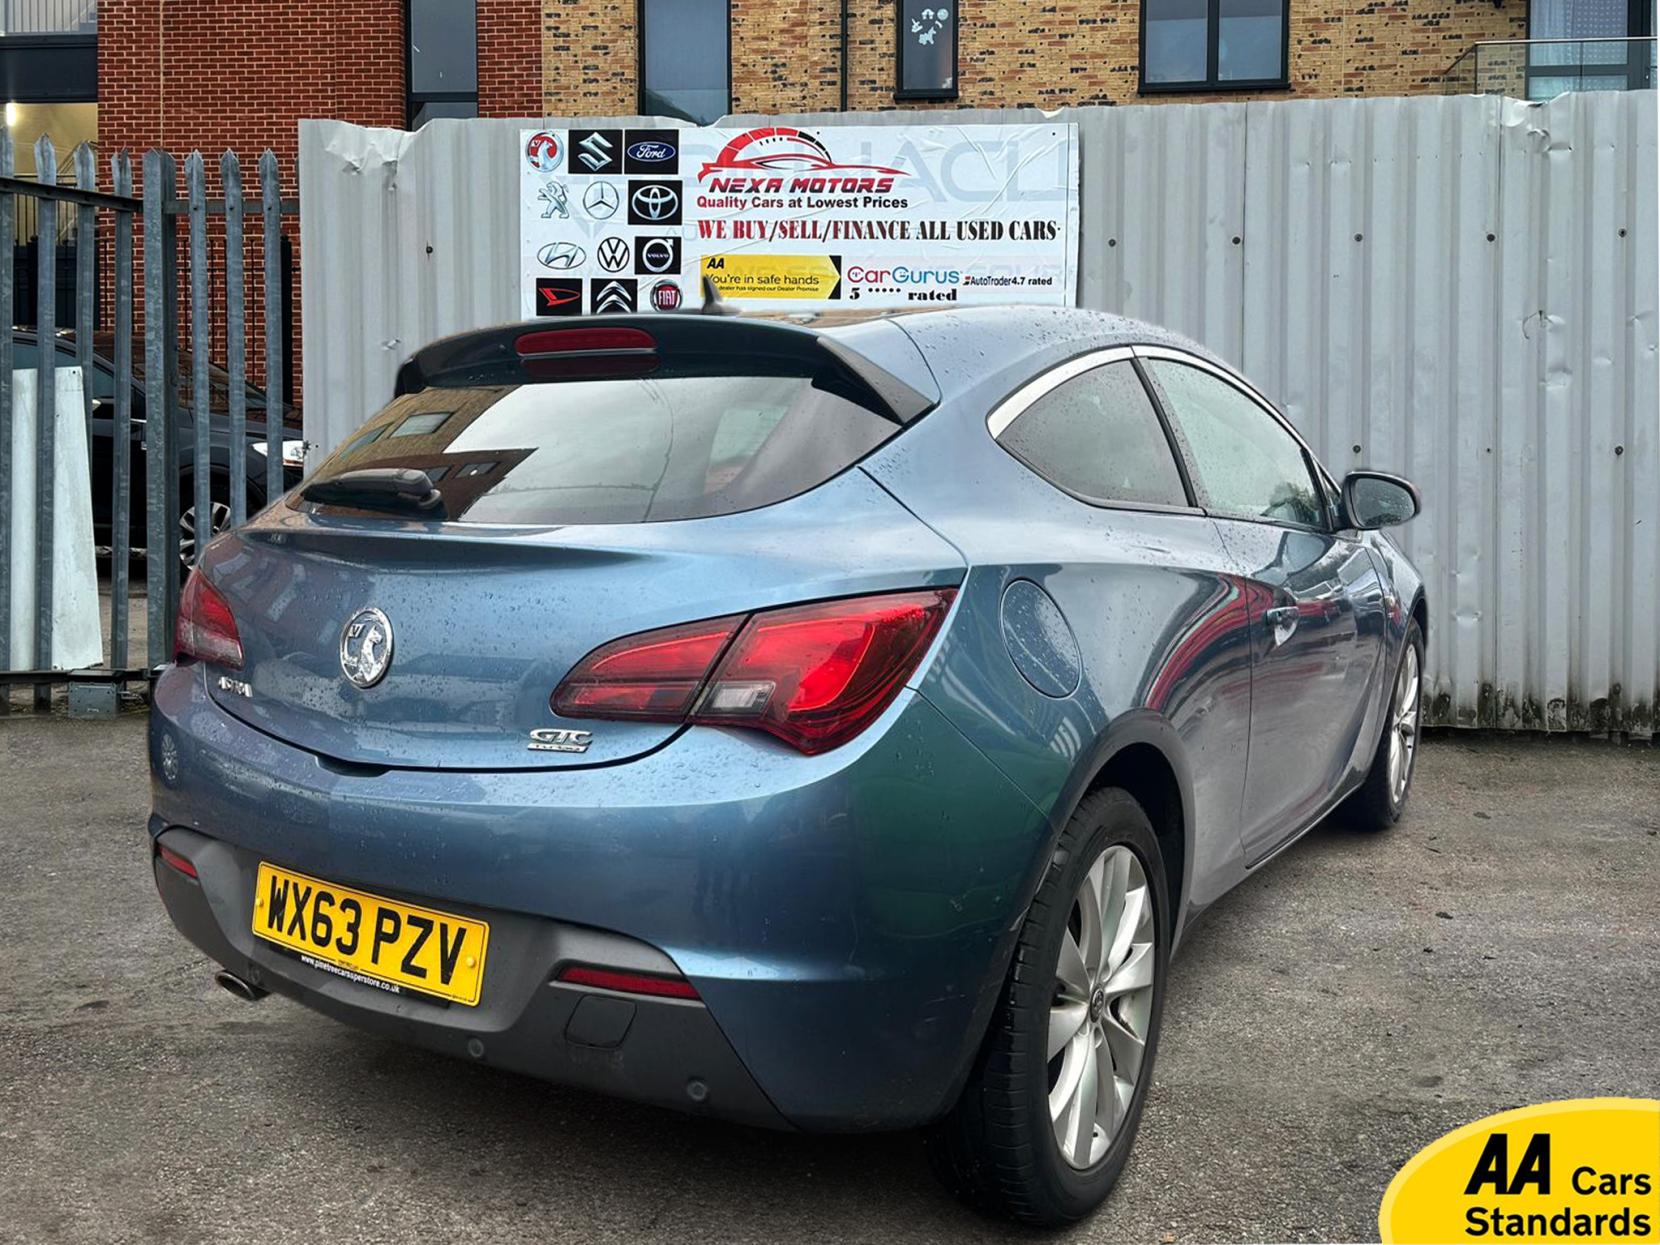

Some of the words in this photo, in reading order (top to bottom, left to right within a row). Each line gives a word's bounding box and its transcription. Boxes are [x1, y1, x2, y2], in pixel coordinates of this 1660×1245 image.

[636, 145, 666, 158] Ford
[709, 178, 784, 193] NEXA
[789, 178, 894, 193] MOTORS
[697, 195, 747, 210] Quality
[751, 196, 783, 207] Cars
[788, 197, 802, 207] at
[807, 196, 858, 207] Lowest
[863, 196, 908, 207] Prices
[697, 220, 727, 239] WE
[916, 220, 950, 240] ALL
[957, 220, 1003, 240] USED
[1008, 220, 1056, 240] CARS
[706, 258, 725, 269] AA
[744, 274, 754, 284] in
[757, 275, 781, 285] safe
[784, 275, 820, 285] hands
[847, 266, 960, 284] CarGurus
[1028, 277, 1053, 286] rated
[658, 290, 677, 306] FIAT
[849, 287, 861, 300] 5
[908, 288, 957, 301] rated
[267, 876, 362, 956] WX63
[371, 906, 467, 986] PZV
